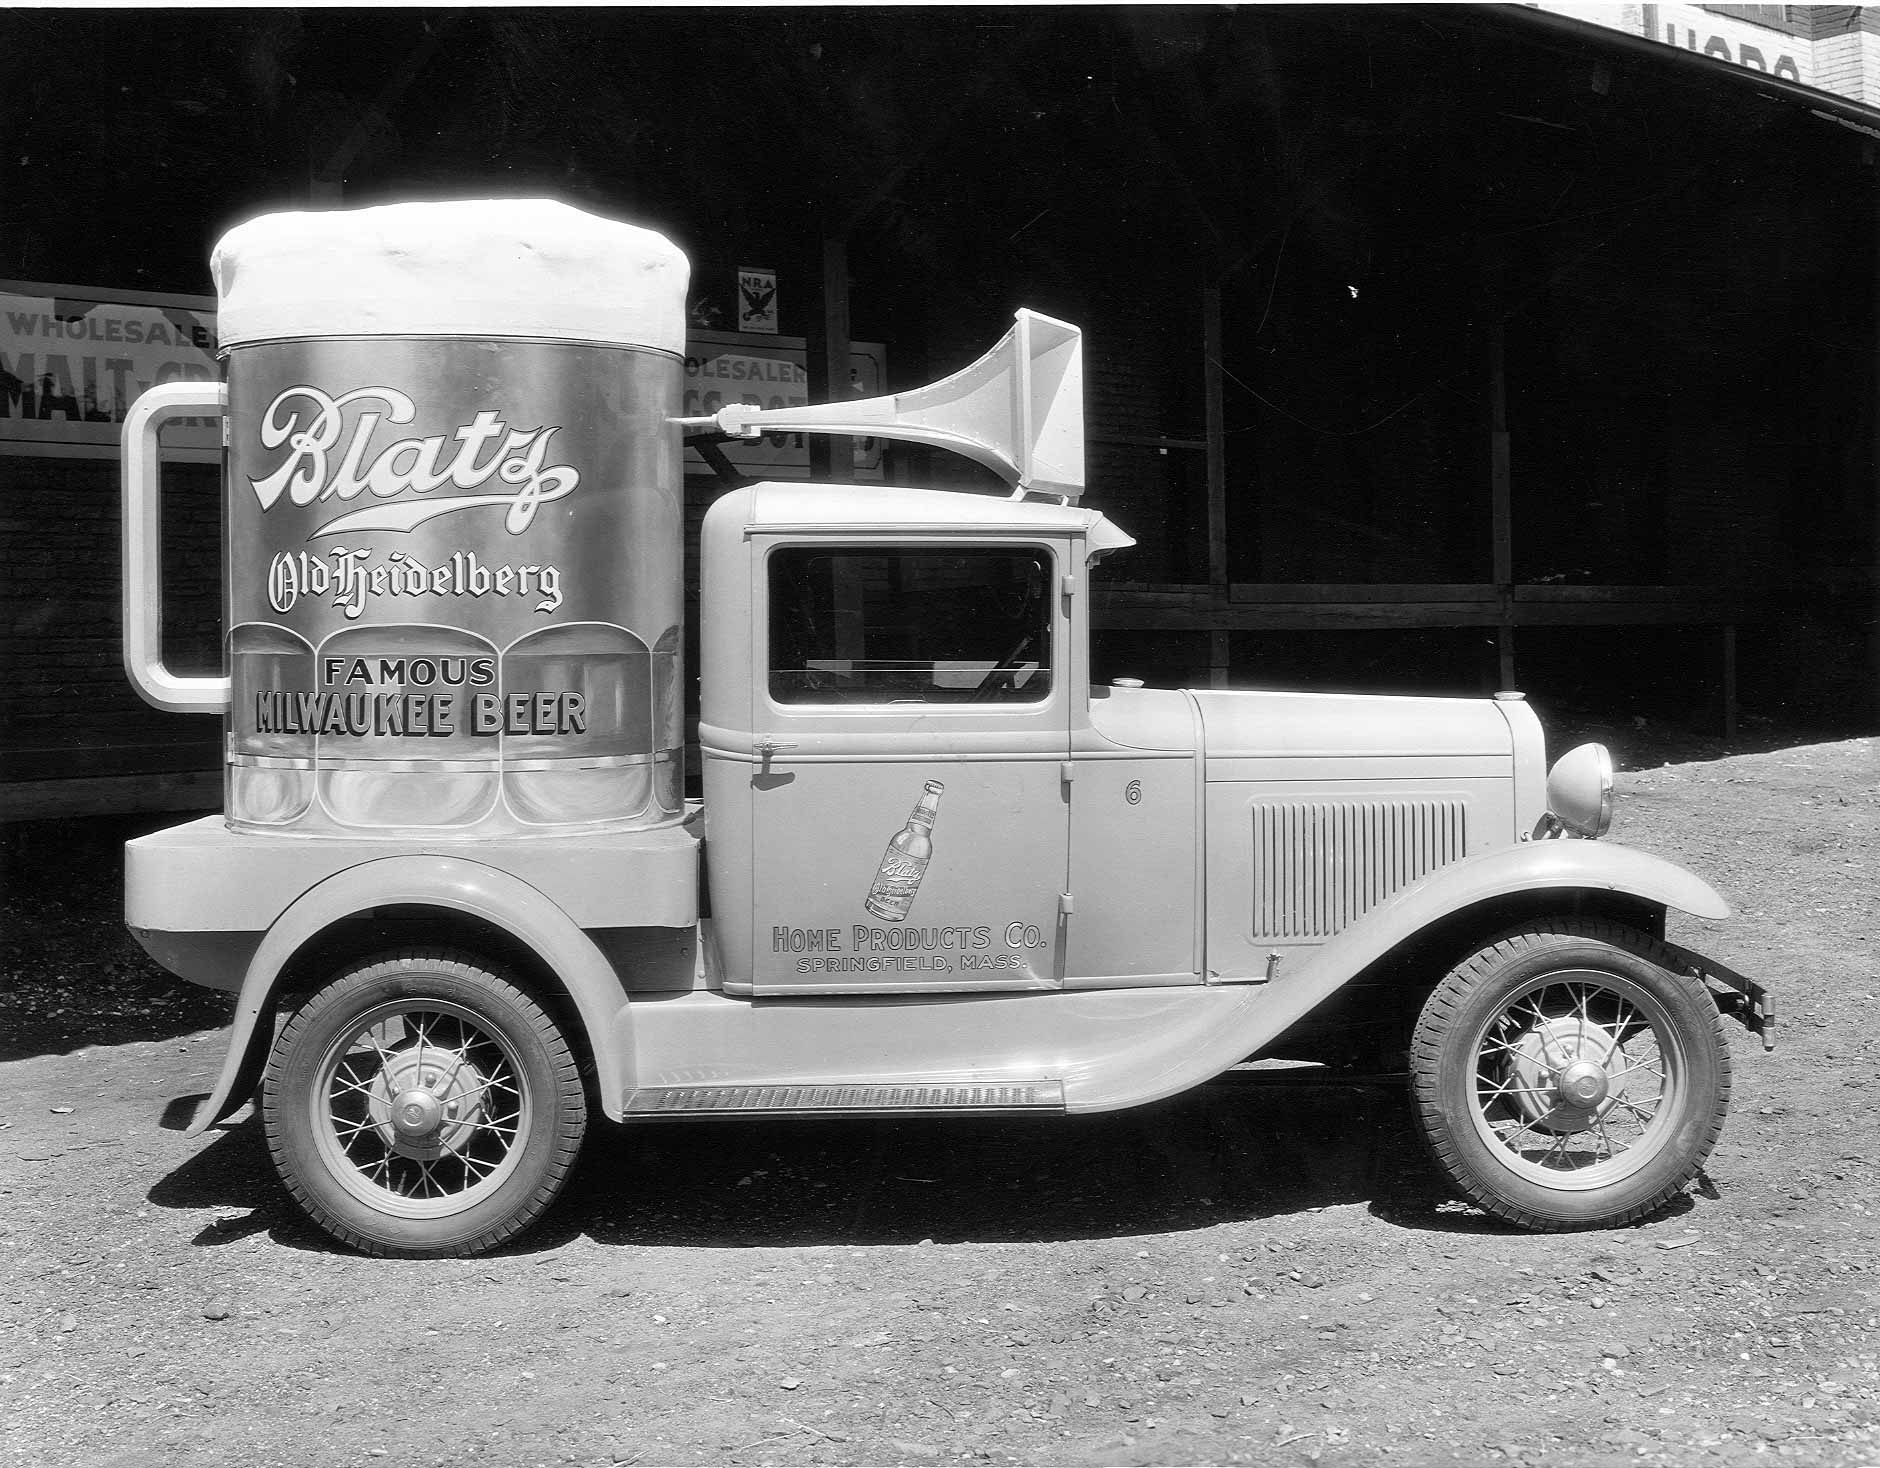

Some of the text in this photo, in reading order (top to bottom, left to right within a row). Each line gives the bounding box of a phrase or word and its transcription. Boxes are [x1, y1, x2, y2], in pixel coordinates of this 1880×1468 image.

[742, 277, 774, 289] NRA
[247, 384, 581, 542] Blatz
[267, 551, 331, 614] Old
[324, 657, 496, 687] FAMOUS
[256, 690, 587, 737] MILWAUKEE BEER
[1125, 779, 1142, 806] 6
[772, 925, 841, 953] HOME
[852, 923, 992, 952] PRODUCTS
[796, 953, 1028, 974] SPRINGFIELD, MASS.
